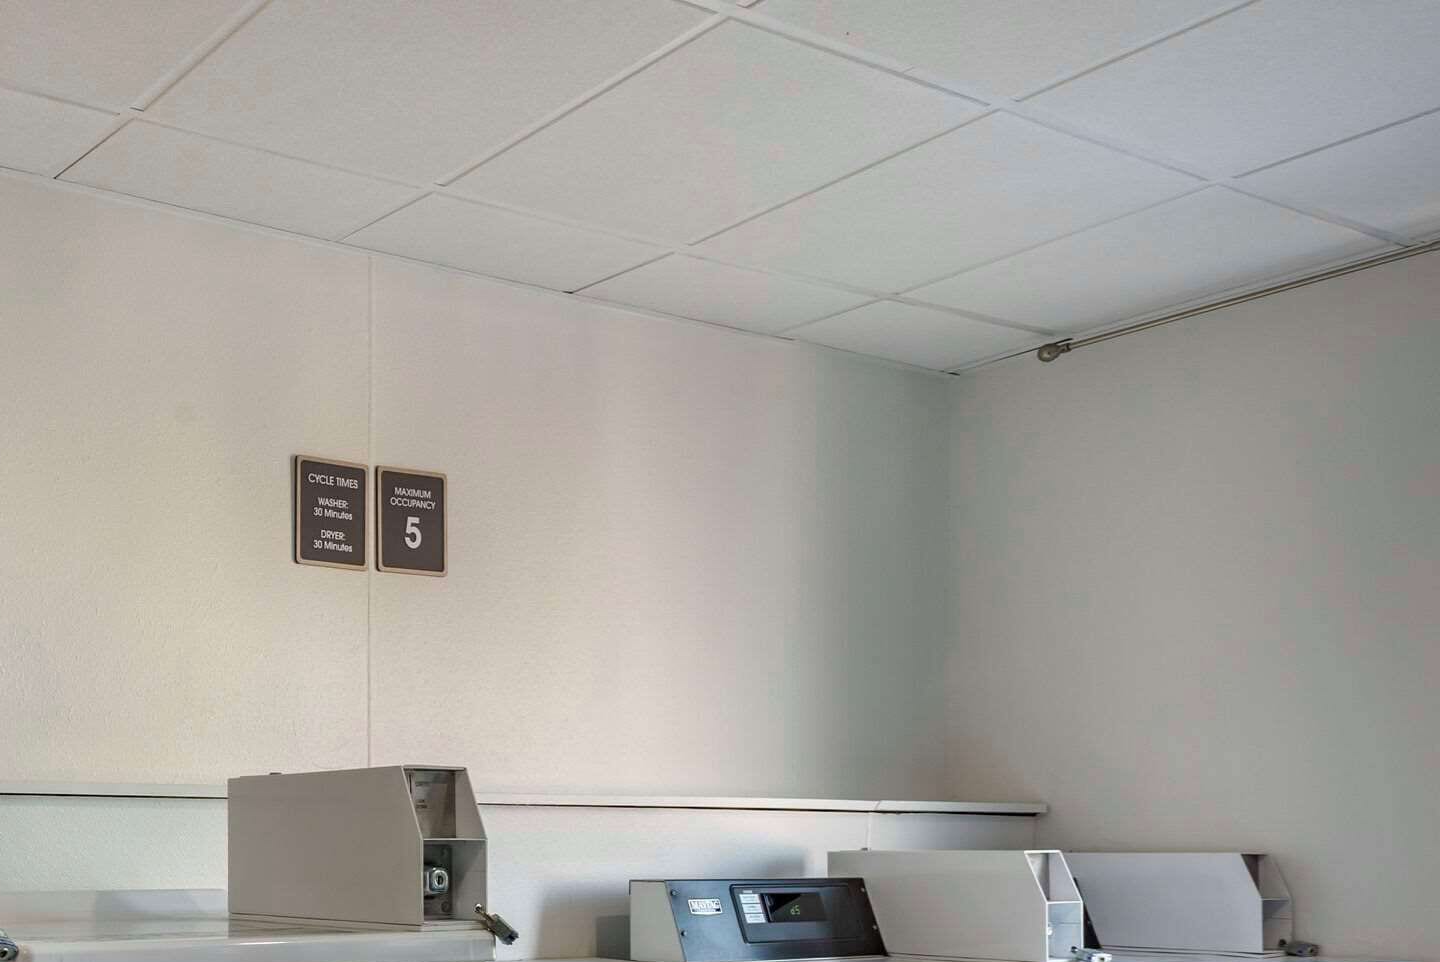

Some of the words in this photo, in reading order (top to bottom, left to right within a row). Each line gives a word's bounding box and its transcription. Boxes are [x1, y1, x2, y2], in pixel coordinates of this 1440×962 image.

[308, 473, 335, 486] CYCLE
[336, 477, 358, 489] TIMES
[394, 487, 431, 499] MAXIMUM
[318, 497, 349, 509] WASHER:
[390, 497, 436, 510] OCCUPANCY
[313, 507, 323, 516] 30
[324, 508, 353, 521] Minutes
[320, 530, 346, 541] DRYER:
[405, 516, 422, 549] 5
[313, 540, 323, 549] 30
[324, 541, 353, 553] Minutes
